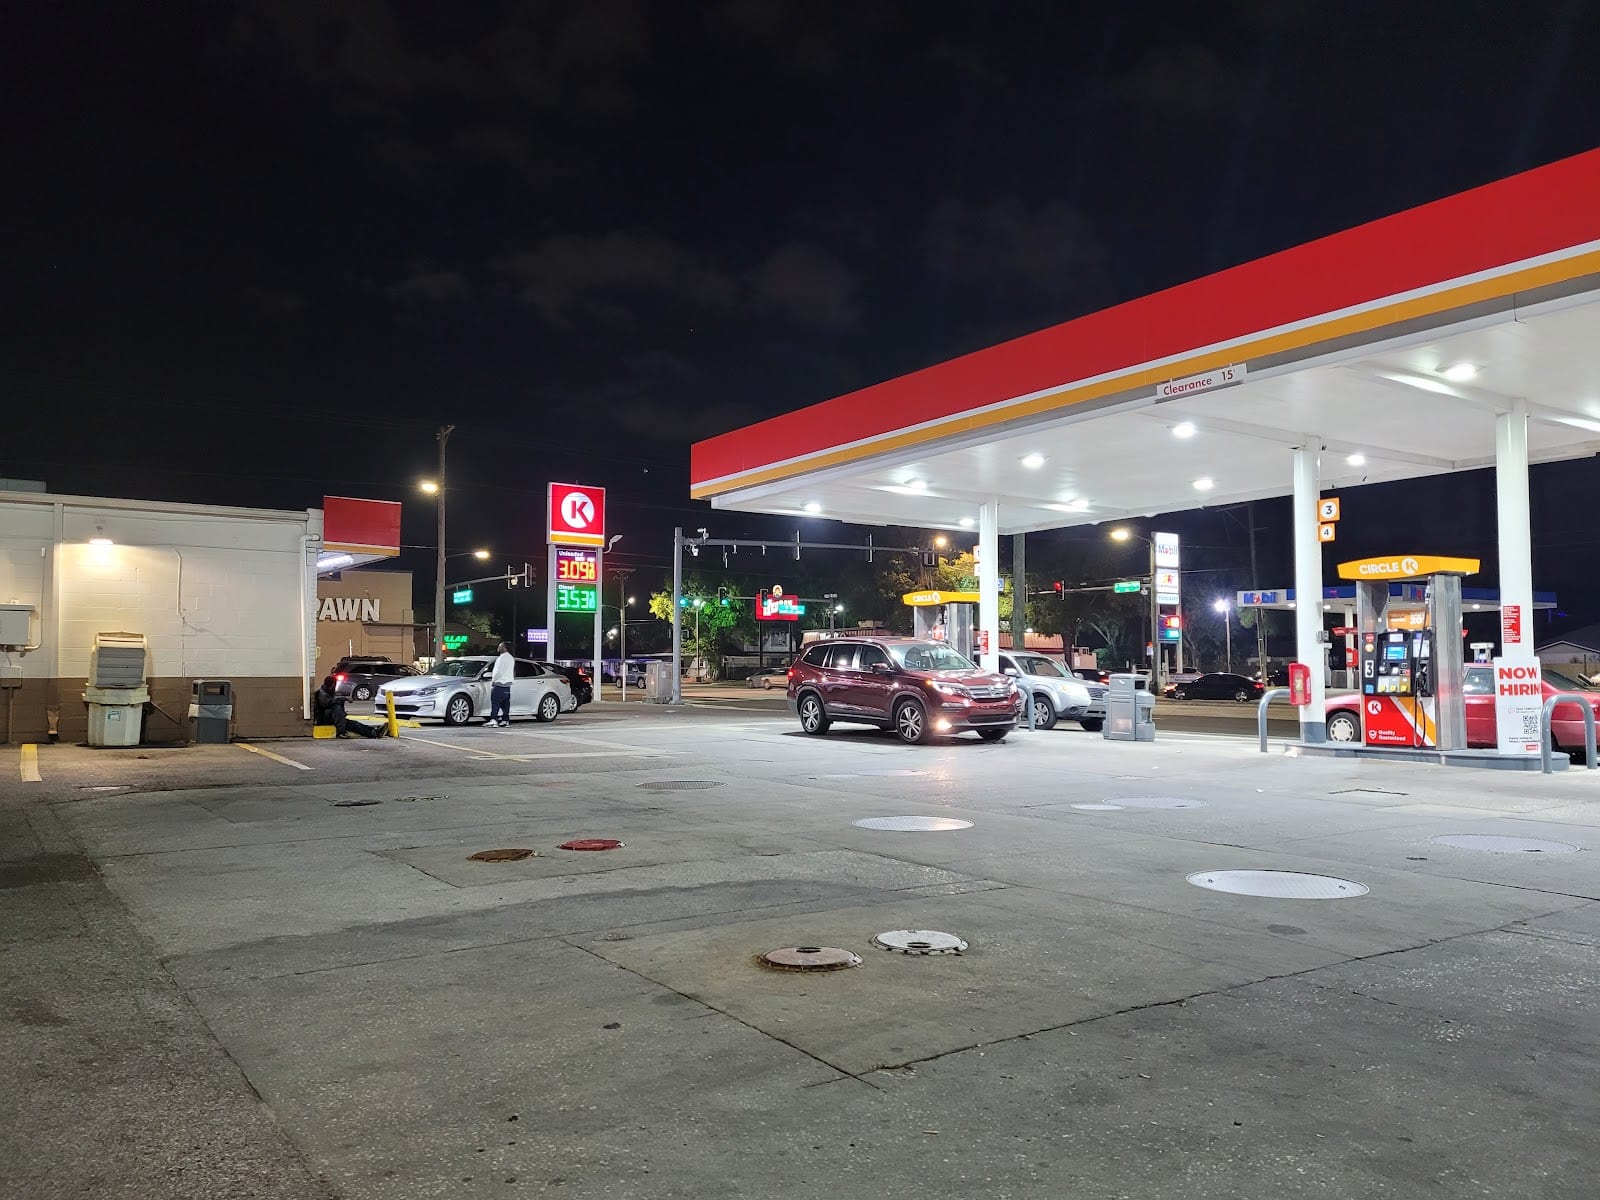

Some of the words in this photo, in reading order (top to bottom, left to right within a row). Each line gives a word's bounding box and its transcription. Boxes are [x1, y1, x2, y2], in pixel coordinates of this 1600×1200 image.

[1163, 378, 1212, 395] Clearance
[570, 500, 592, 526] K
[1325, 505, 1333, 515] 3
[1323, 528, 1330, 536] 4
[1158, 543, 1178, 556] Mobil
[1359, 562, 1399, 575] CIRCLE
[1401, 558, 1418, 575] K
[1366, 662, 1373, 676] 3
[1499, 667, 1537, 680] NOW
